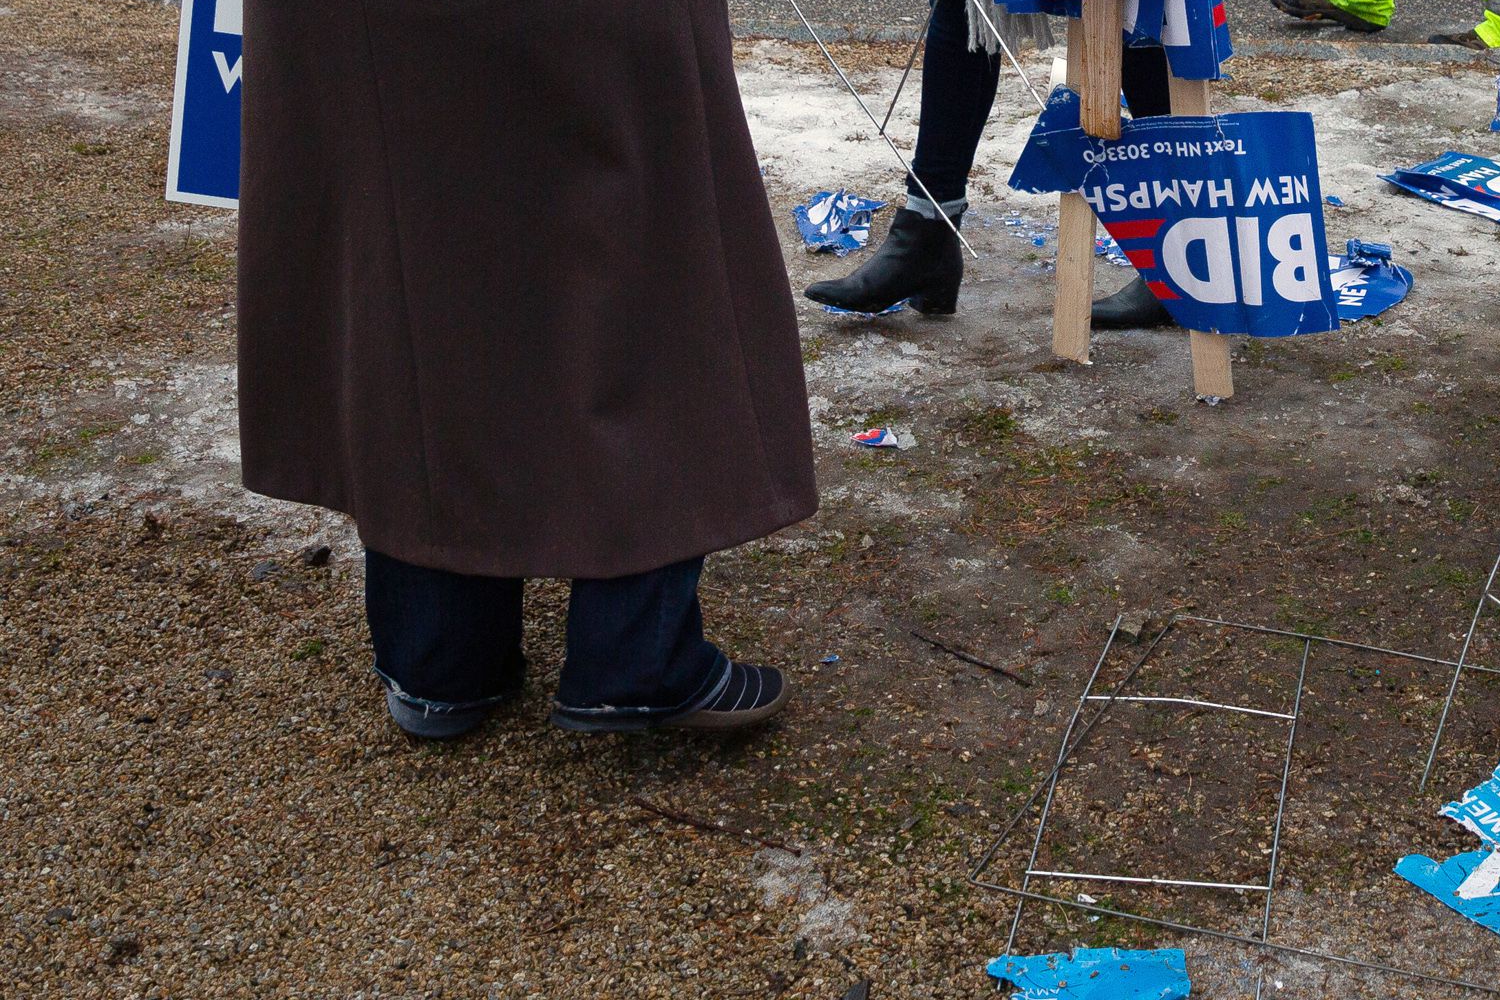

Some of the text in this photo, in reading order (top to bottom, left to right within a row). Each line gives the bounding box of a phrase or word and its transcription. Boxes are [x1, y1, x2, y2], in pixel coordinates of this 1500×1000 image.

[1153, 142, 1173, 157] to
[1175, 141, 1203, 157] NH
[1205, 139, 1246, 155] Text
[1244, 174, 1310, 208] NEW
